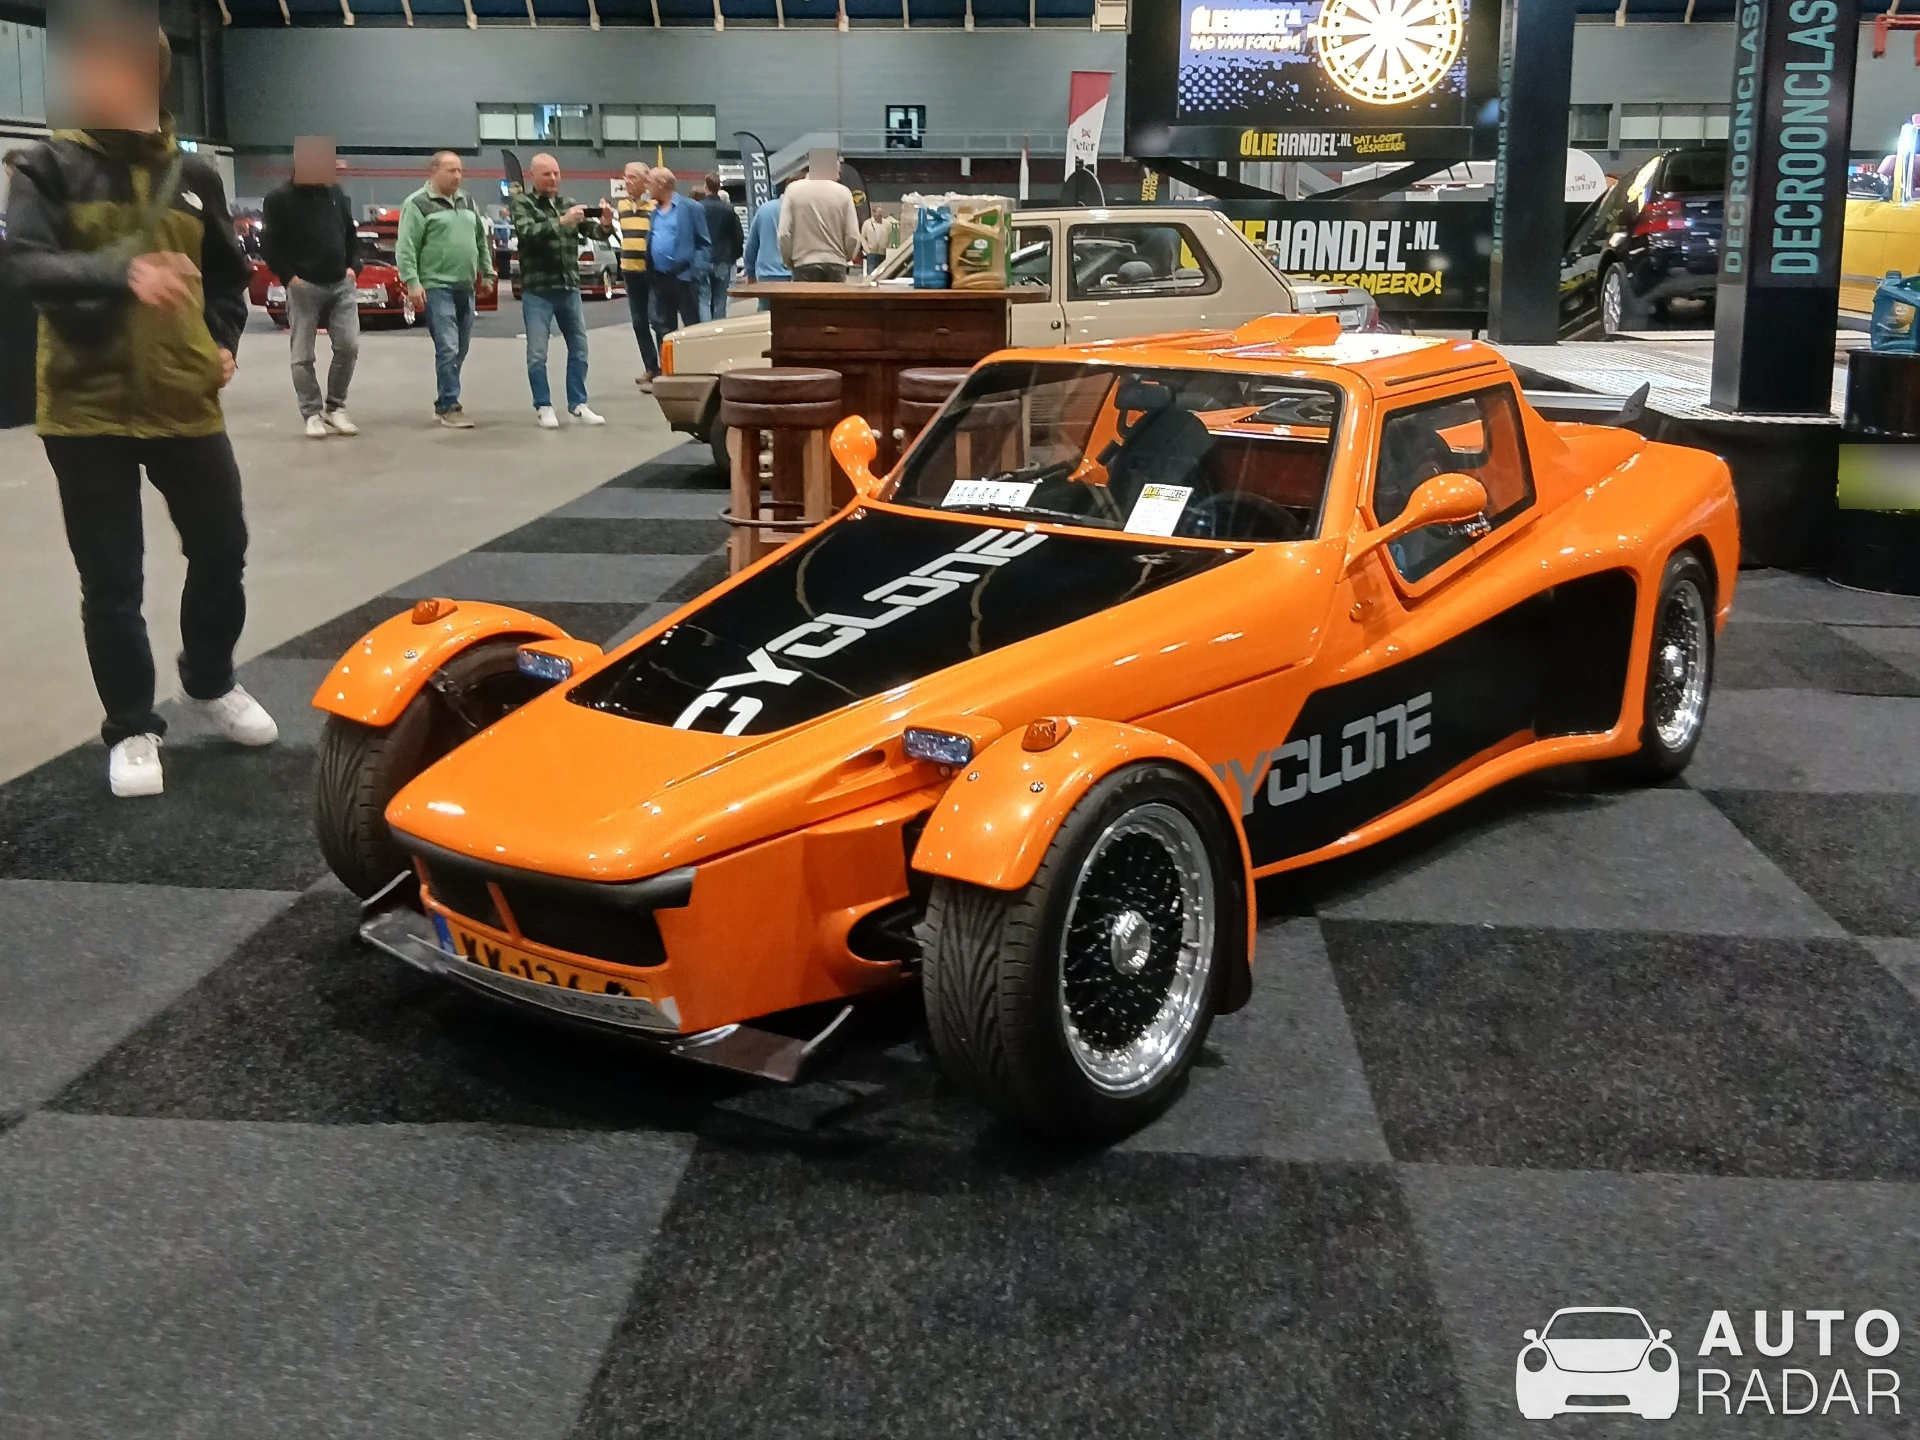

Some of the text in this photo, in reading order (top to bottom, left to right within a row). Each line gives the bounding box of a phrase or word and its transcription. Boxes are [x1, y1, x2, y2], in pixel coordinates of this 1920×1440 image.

[1353, 133, 1403, 145] DAT LOOPT
[1724, 0, 1760, 273] DECROONCLAS
[673, 528, 1049, 736] CYCLONE
